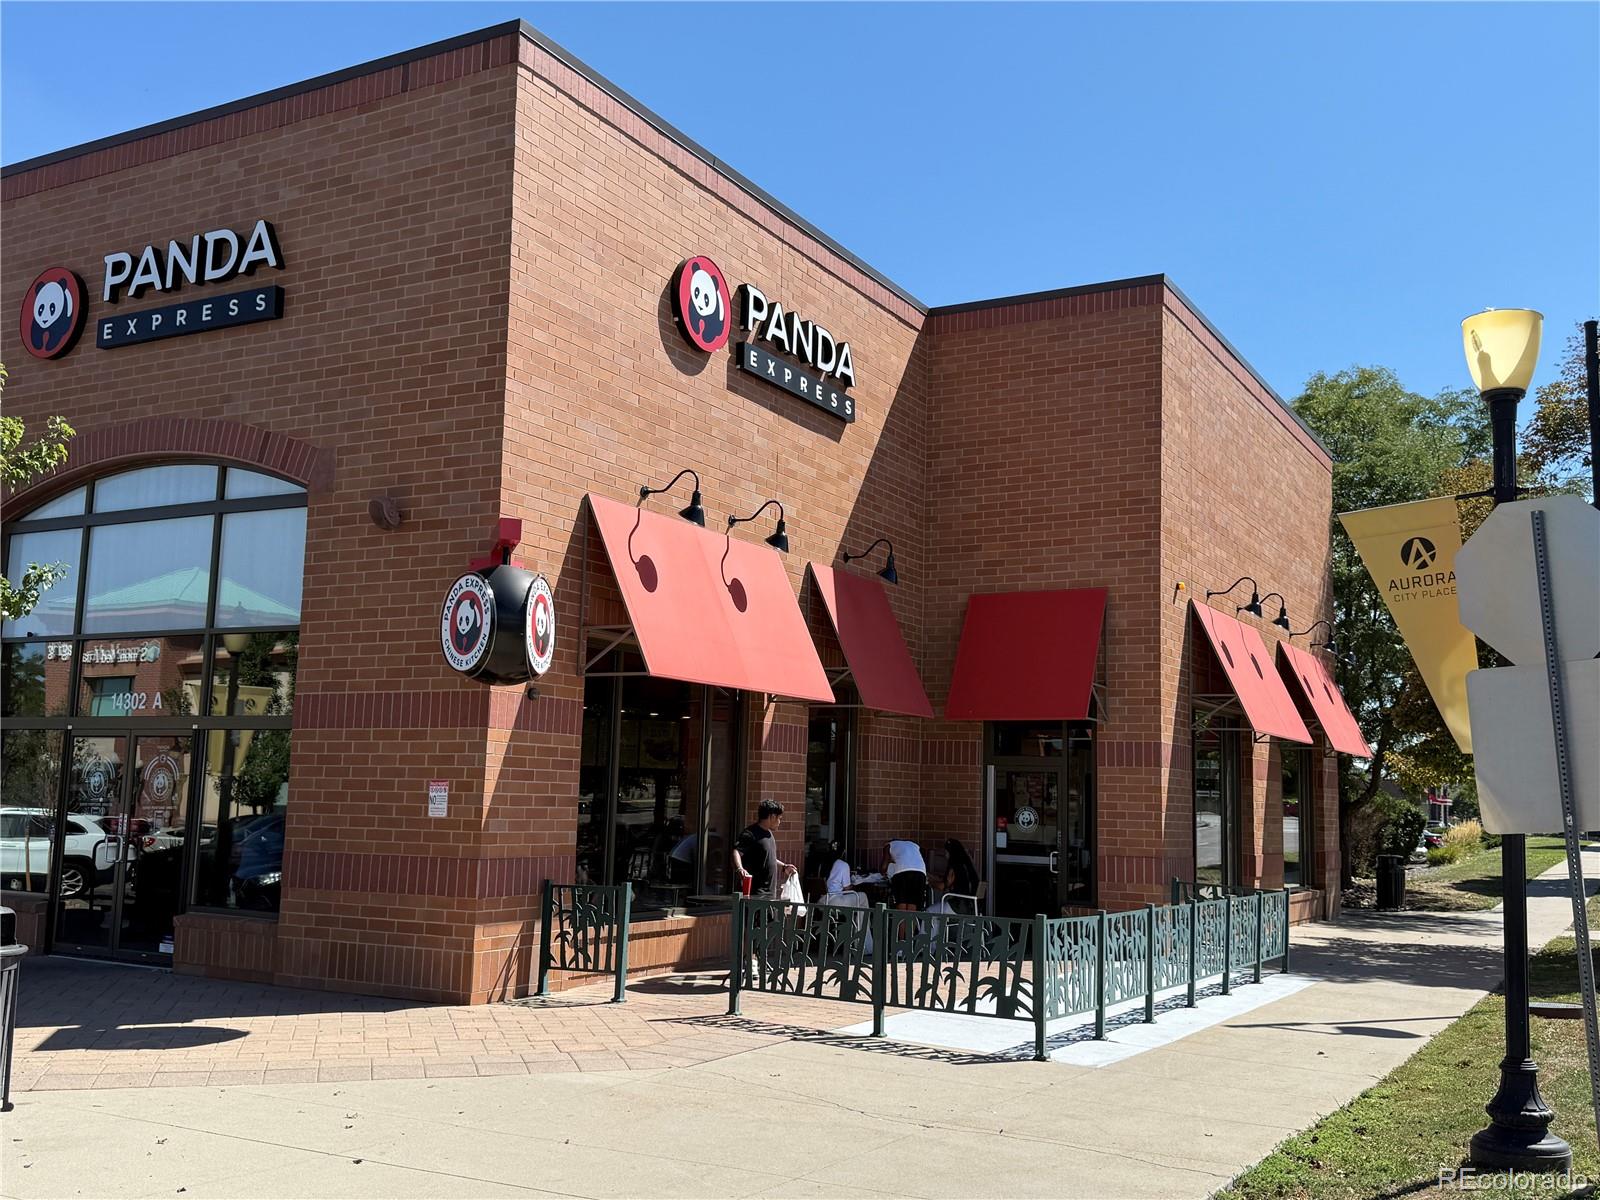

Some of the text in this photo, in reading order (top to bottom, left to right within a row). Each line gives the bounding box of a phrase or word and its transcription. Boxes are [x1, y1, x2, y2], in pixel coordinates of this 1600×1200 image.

[103, 219, 279, 302] PANDA
[102, 294, 267, 340] EXPRESS
[744, 283, 857, 388] PANDA
[749, 350, 852, 415] EXPRESS
[443, 583, 464, 621] PANDA
[465, 577, 490, 615] EXPRESS
[1388, 570, 1457, 592] AURORA
[1393, 586, 1457, 602] CITY PLACE
[444, 633, 488, 667] CHINESE KITCHEN
[111, 691, 162, 710] 14302 A
